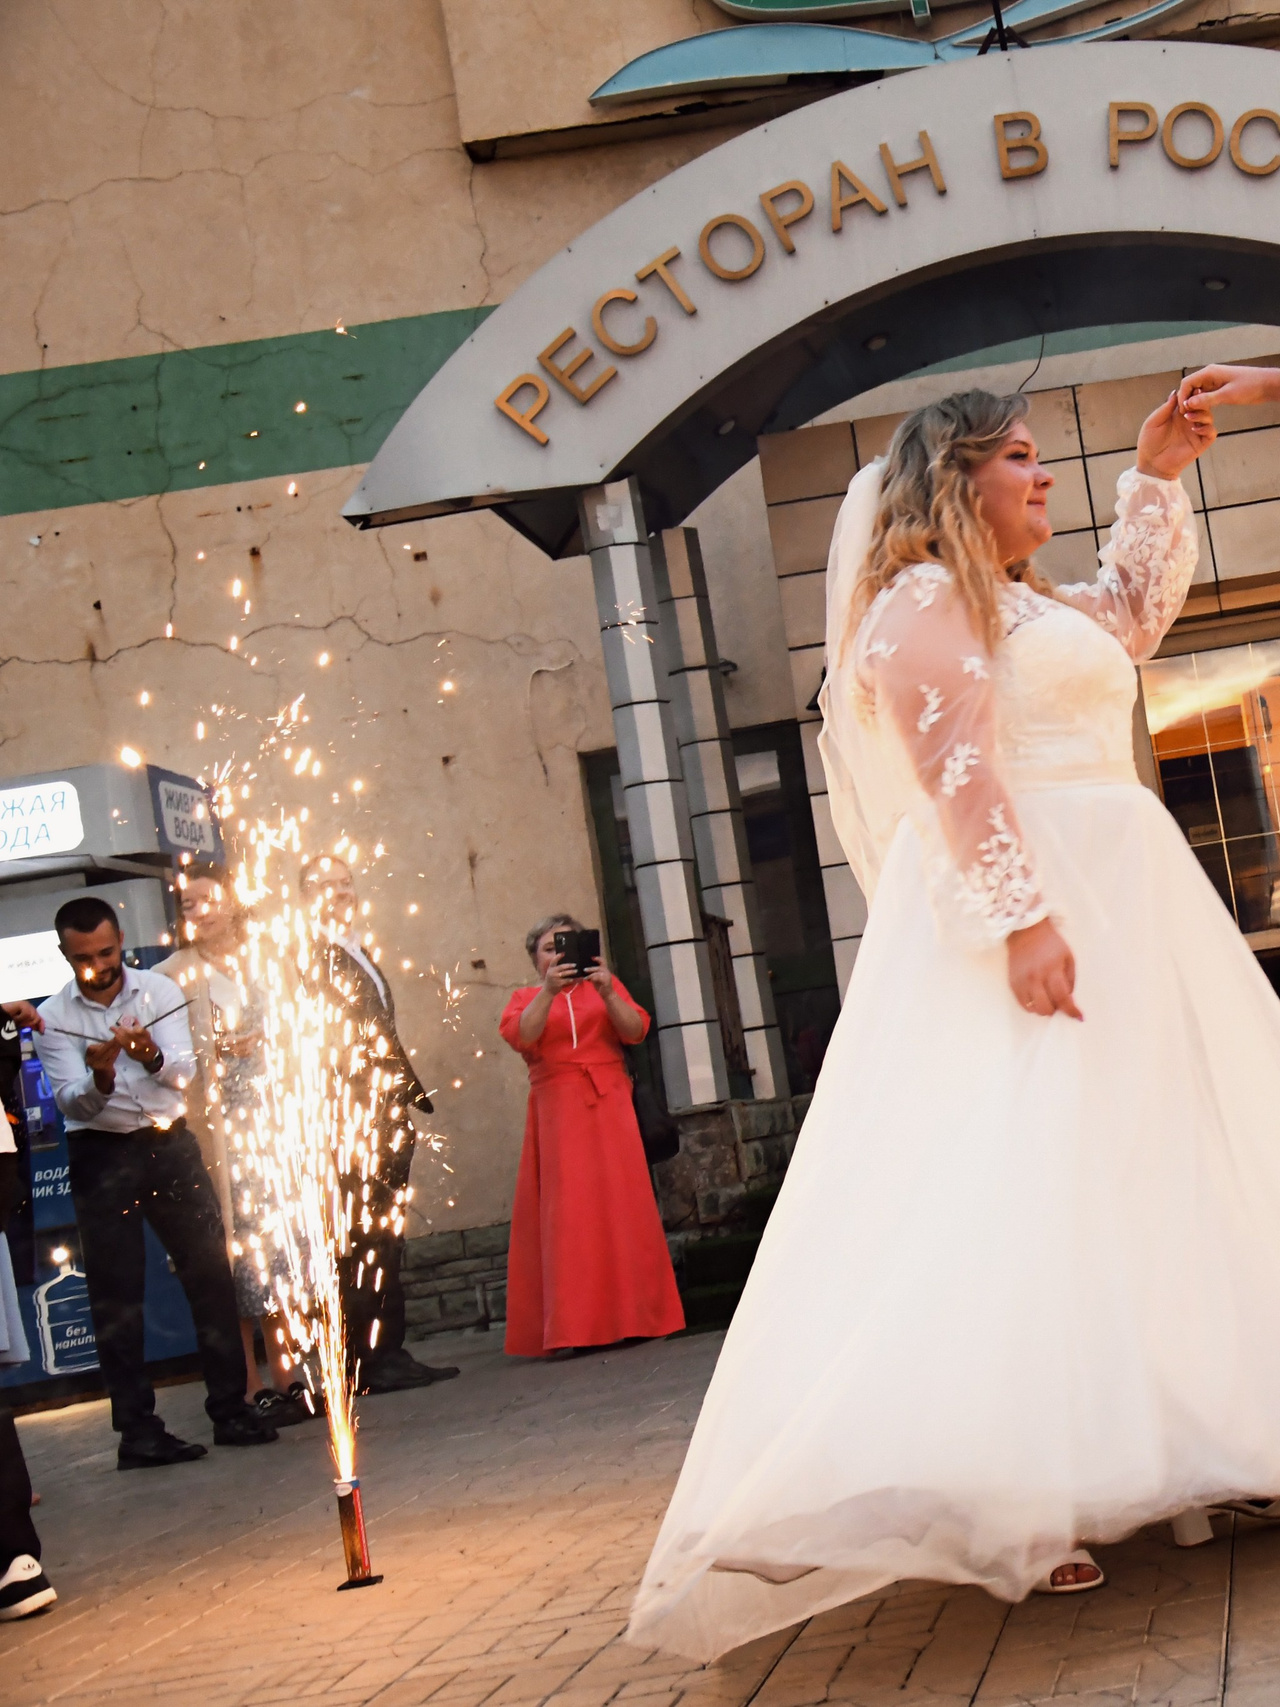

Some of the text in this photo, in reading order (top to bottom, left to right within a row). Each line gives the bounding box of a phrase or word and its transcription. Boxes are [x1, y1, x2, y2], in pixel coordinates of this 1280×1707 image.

[494, 130, 947, 446] РЕСТОРАН
[993, 111, 1049, 180] В
[34, 1165, 70, 1182] ВОДА
[55, 1334, 96, 1350] накип
